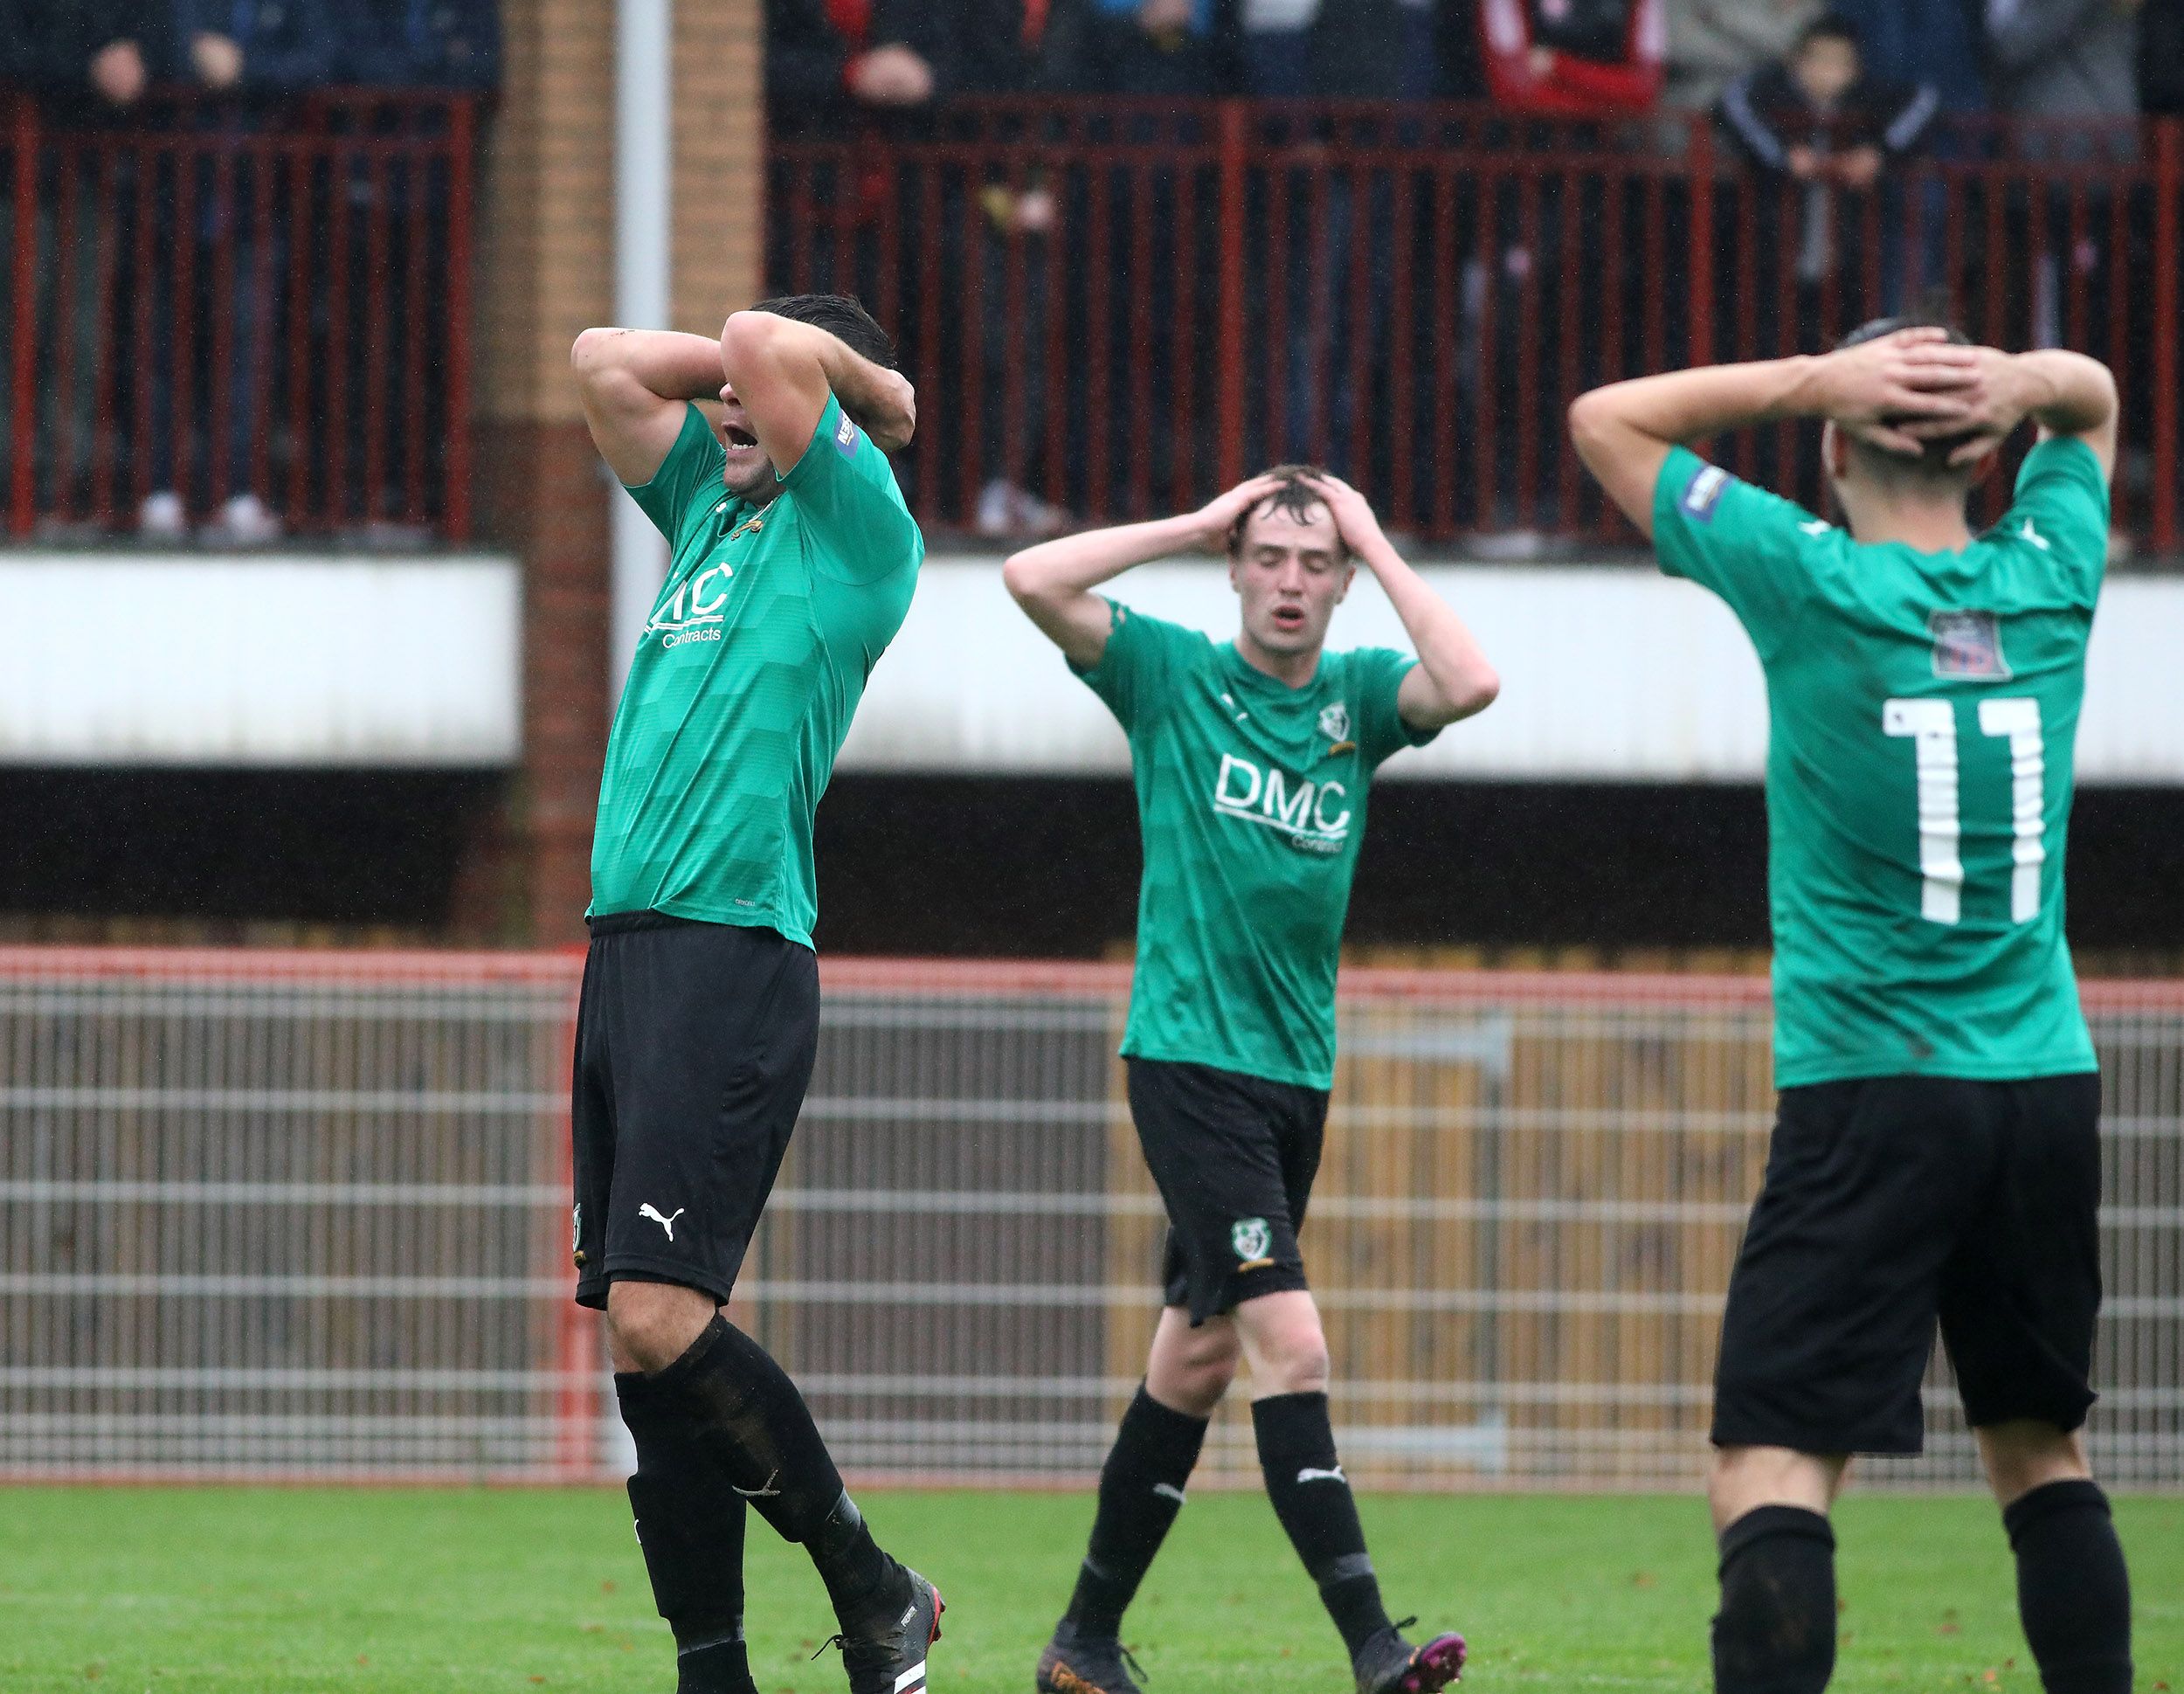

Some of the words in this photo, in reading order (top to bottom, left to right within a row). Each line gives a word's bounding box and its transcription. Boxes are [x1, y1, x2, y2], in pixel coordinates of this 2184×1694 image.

[662, 626, 722, 649] Contracts
[1214, 753, 1351, 832] DMC
[1883, 697, 2046, 925] 11
